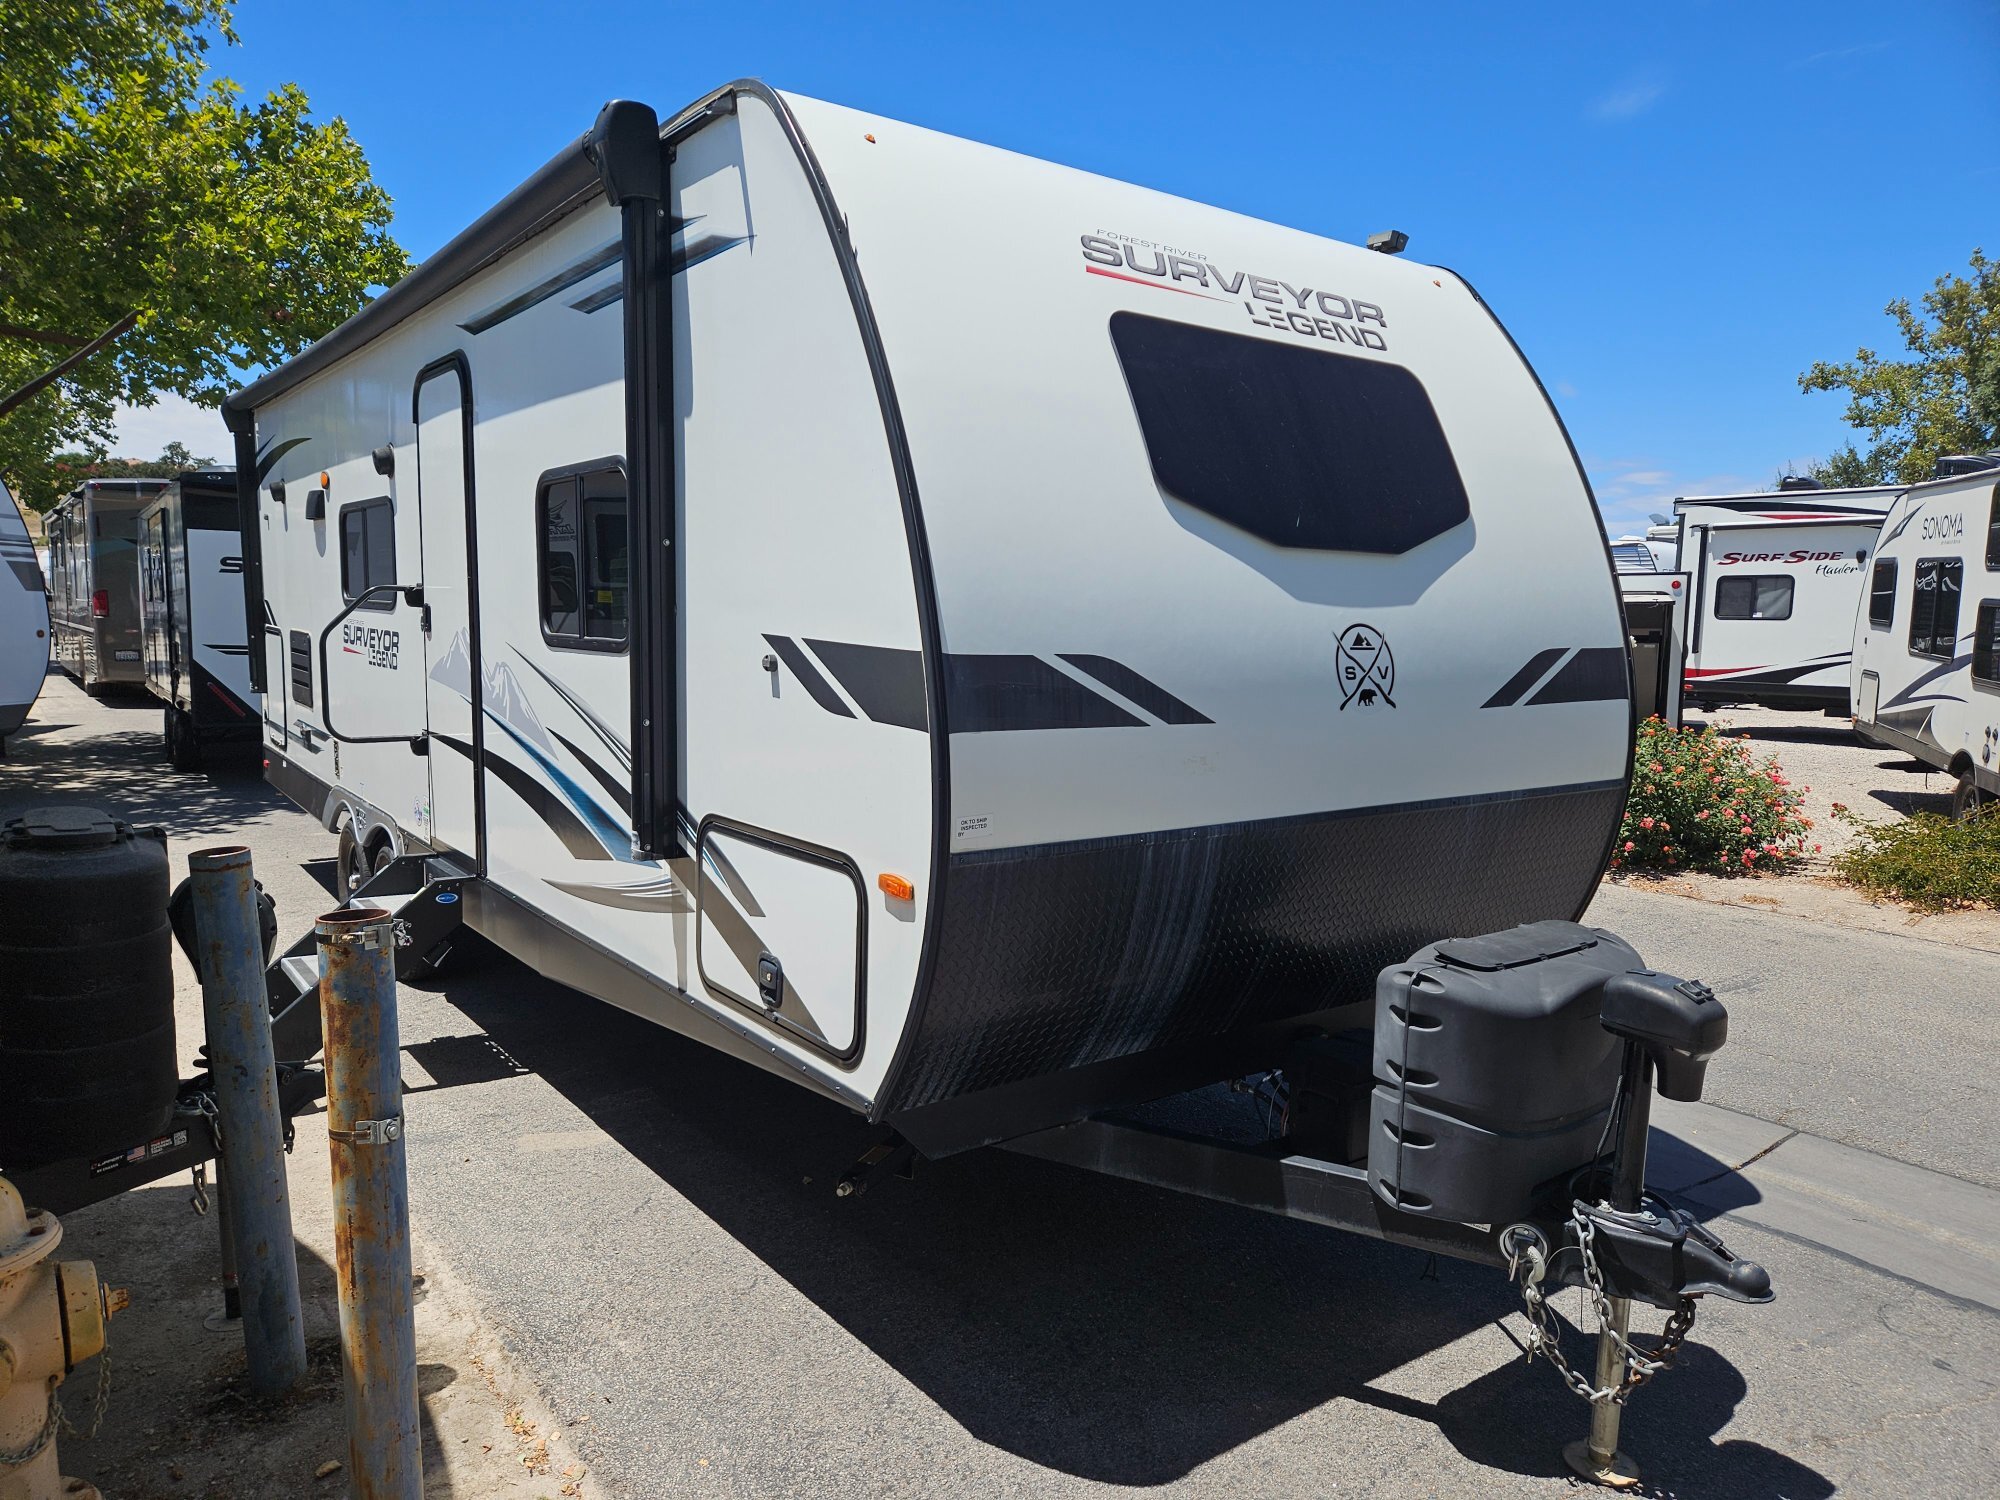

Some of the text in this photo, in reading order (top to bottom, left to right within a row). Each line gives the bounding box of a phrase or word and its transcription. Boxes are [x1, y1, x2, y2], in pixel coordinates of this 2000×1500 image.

[1096, 228, 1207, 262] FOREST RIVER
[1080, 233, 1388, 328] SURVEYOR
[1244, 301, 1388, 352] LEGEND
[1922, 512, 1963, 540] SONOMA
[1815, 563, 1858, 577] Hauler
[343, 624, 400, 653] SURVEYOR
[368, 648, 398, 670] LEGEND
[960, 823, 988, 831] INSPECTED
